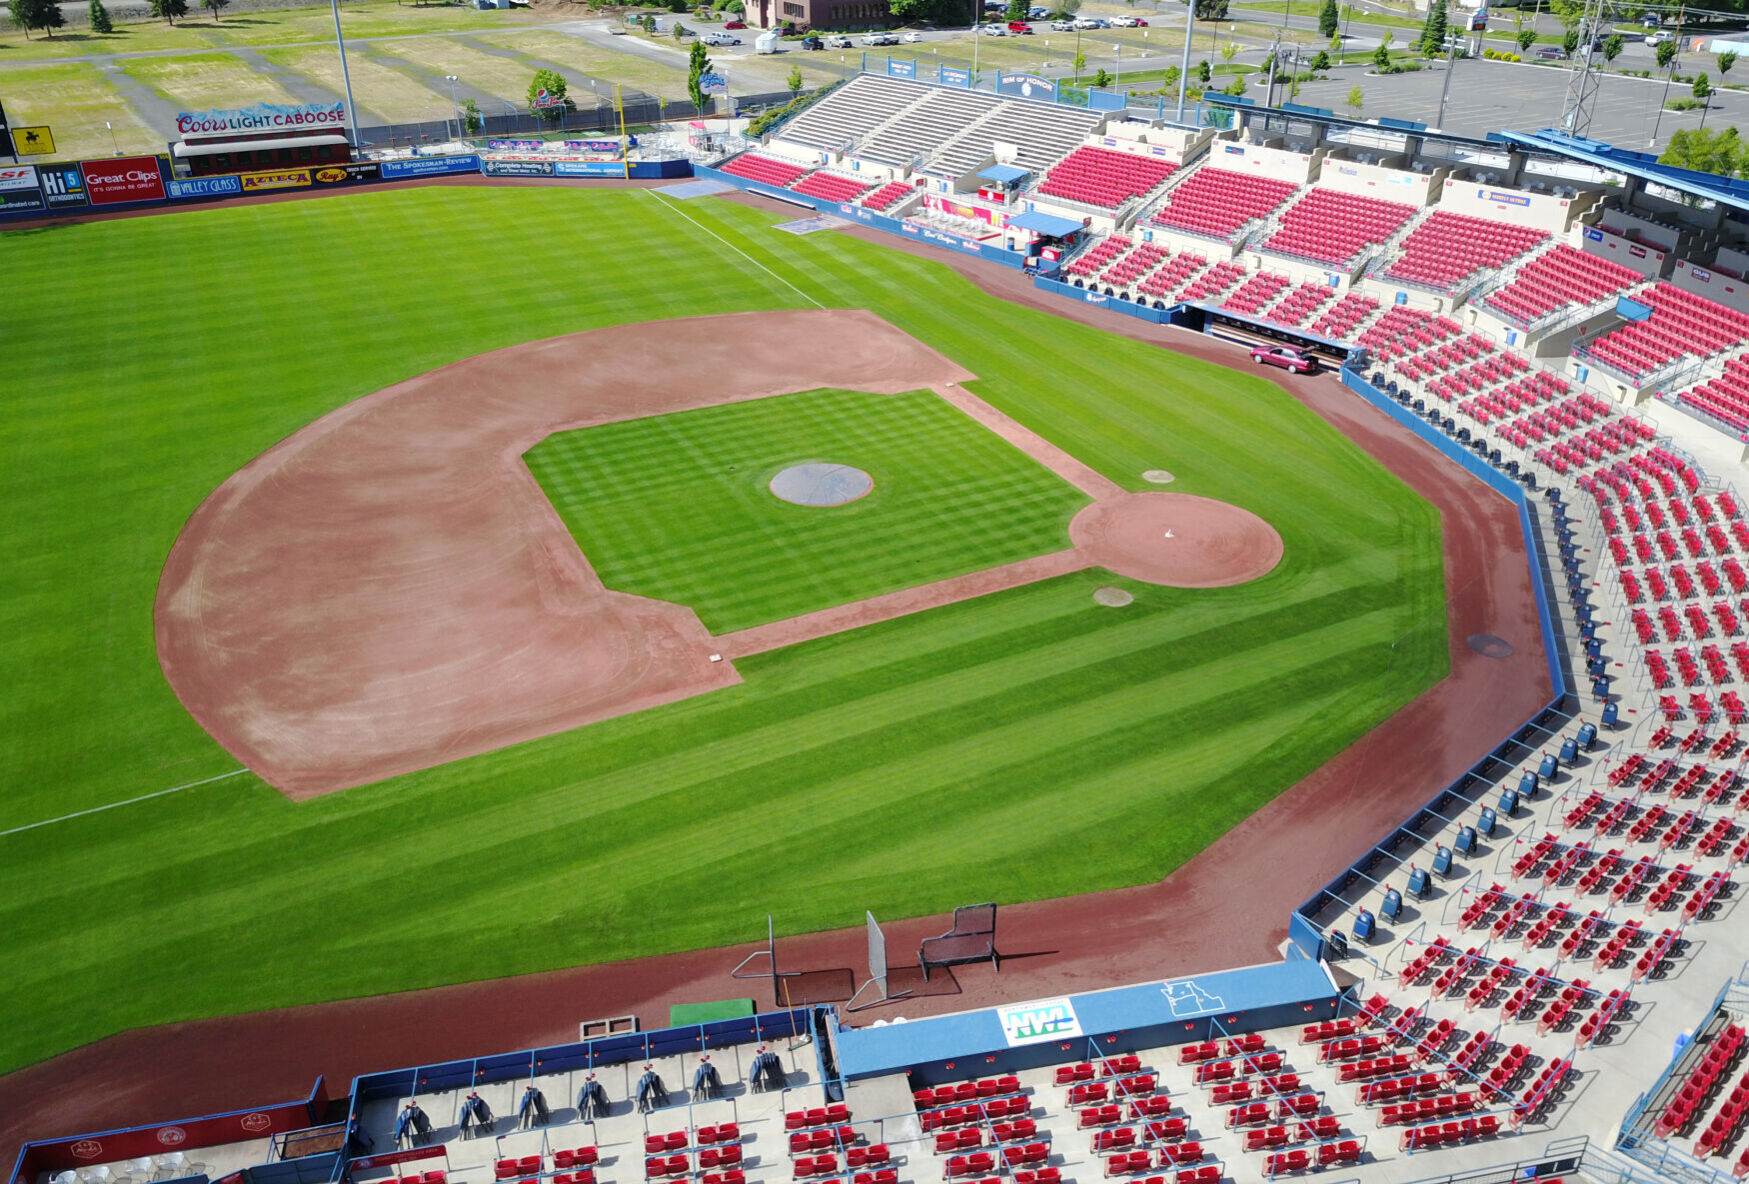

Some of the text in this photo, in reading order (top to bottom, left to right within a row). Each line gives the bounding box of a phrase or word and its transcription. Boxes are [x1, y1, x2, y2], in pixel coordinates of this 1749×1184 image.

[1026, 77, 1053, 91] HONOR
[176, 110, 345, 133] Coors LIGHT CABOOSE
[403, 158, 472, 169] SPOKESMAN-REVIEW
[42, 172, 66, 195] Hi
[67, 173, 75, 186] 5
[86, 171, 157, 184] Great Clips
[245, 173, 310, 187] AZTECA
[320, 171, 345, 182] Ray's
[181, 178, 237, 193] VALLEY GLASS
[48, 193, 85, 202] ORTHODONTICS
[1009, 1006, 1073, 1037] NWL
